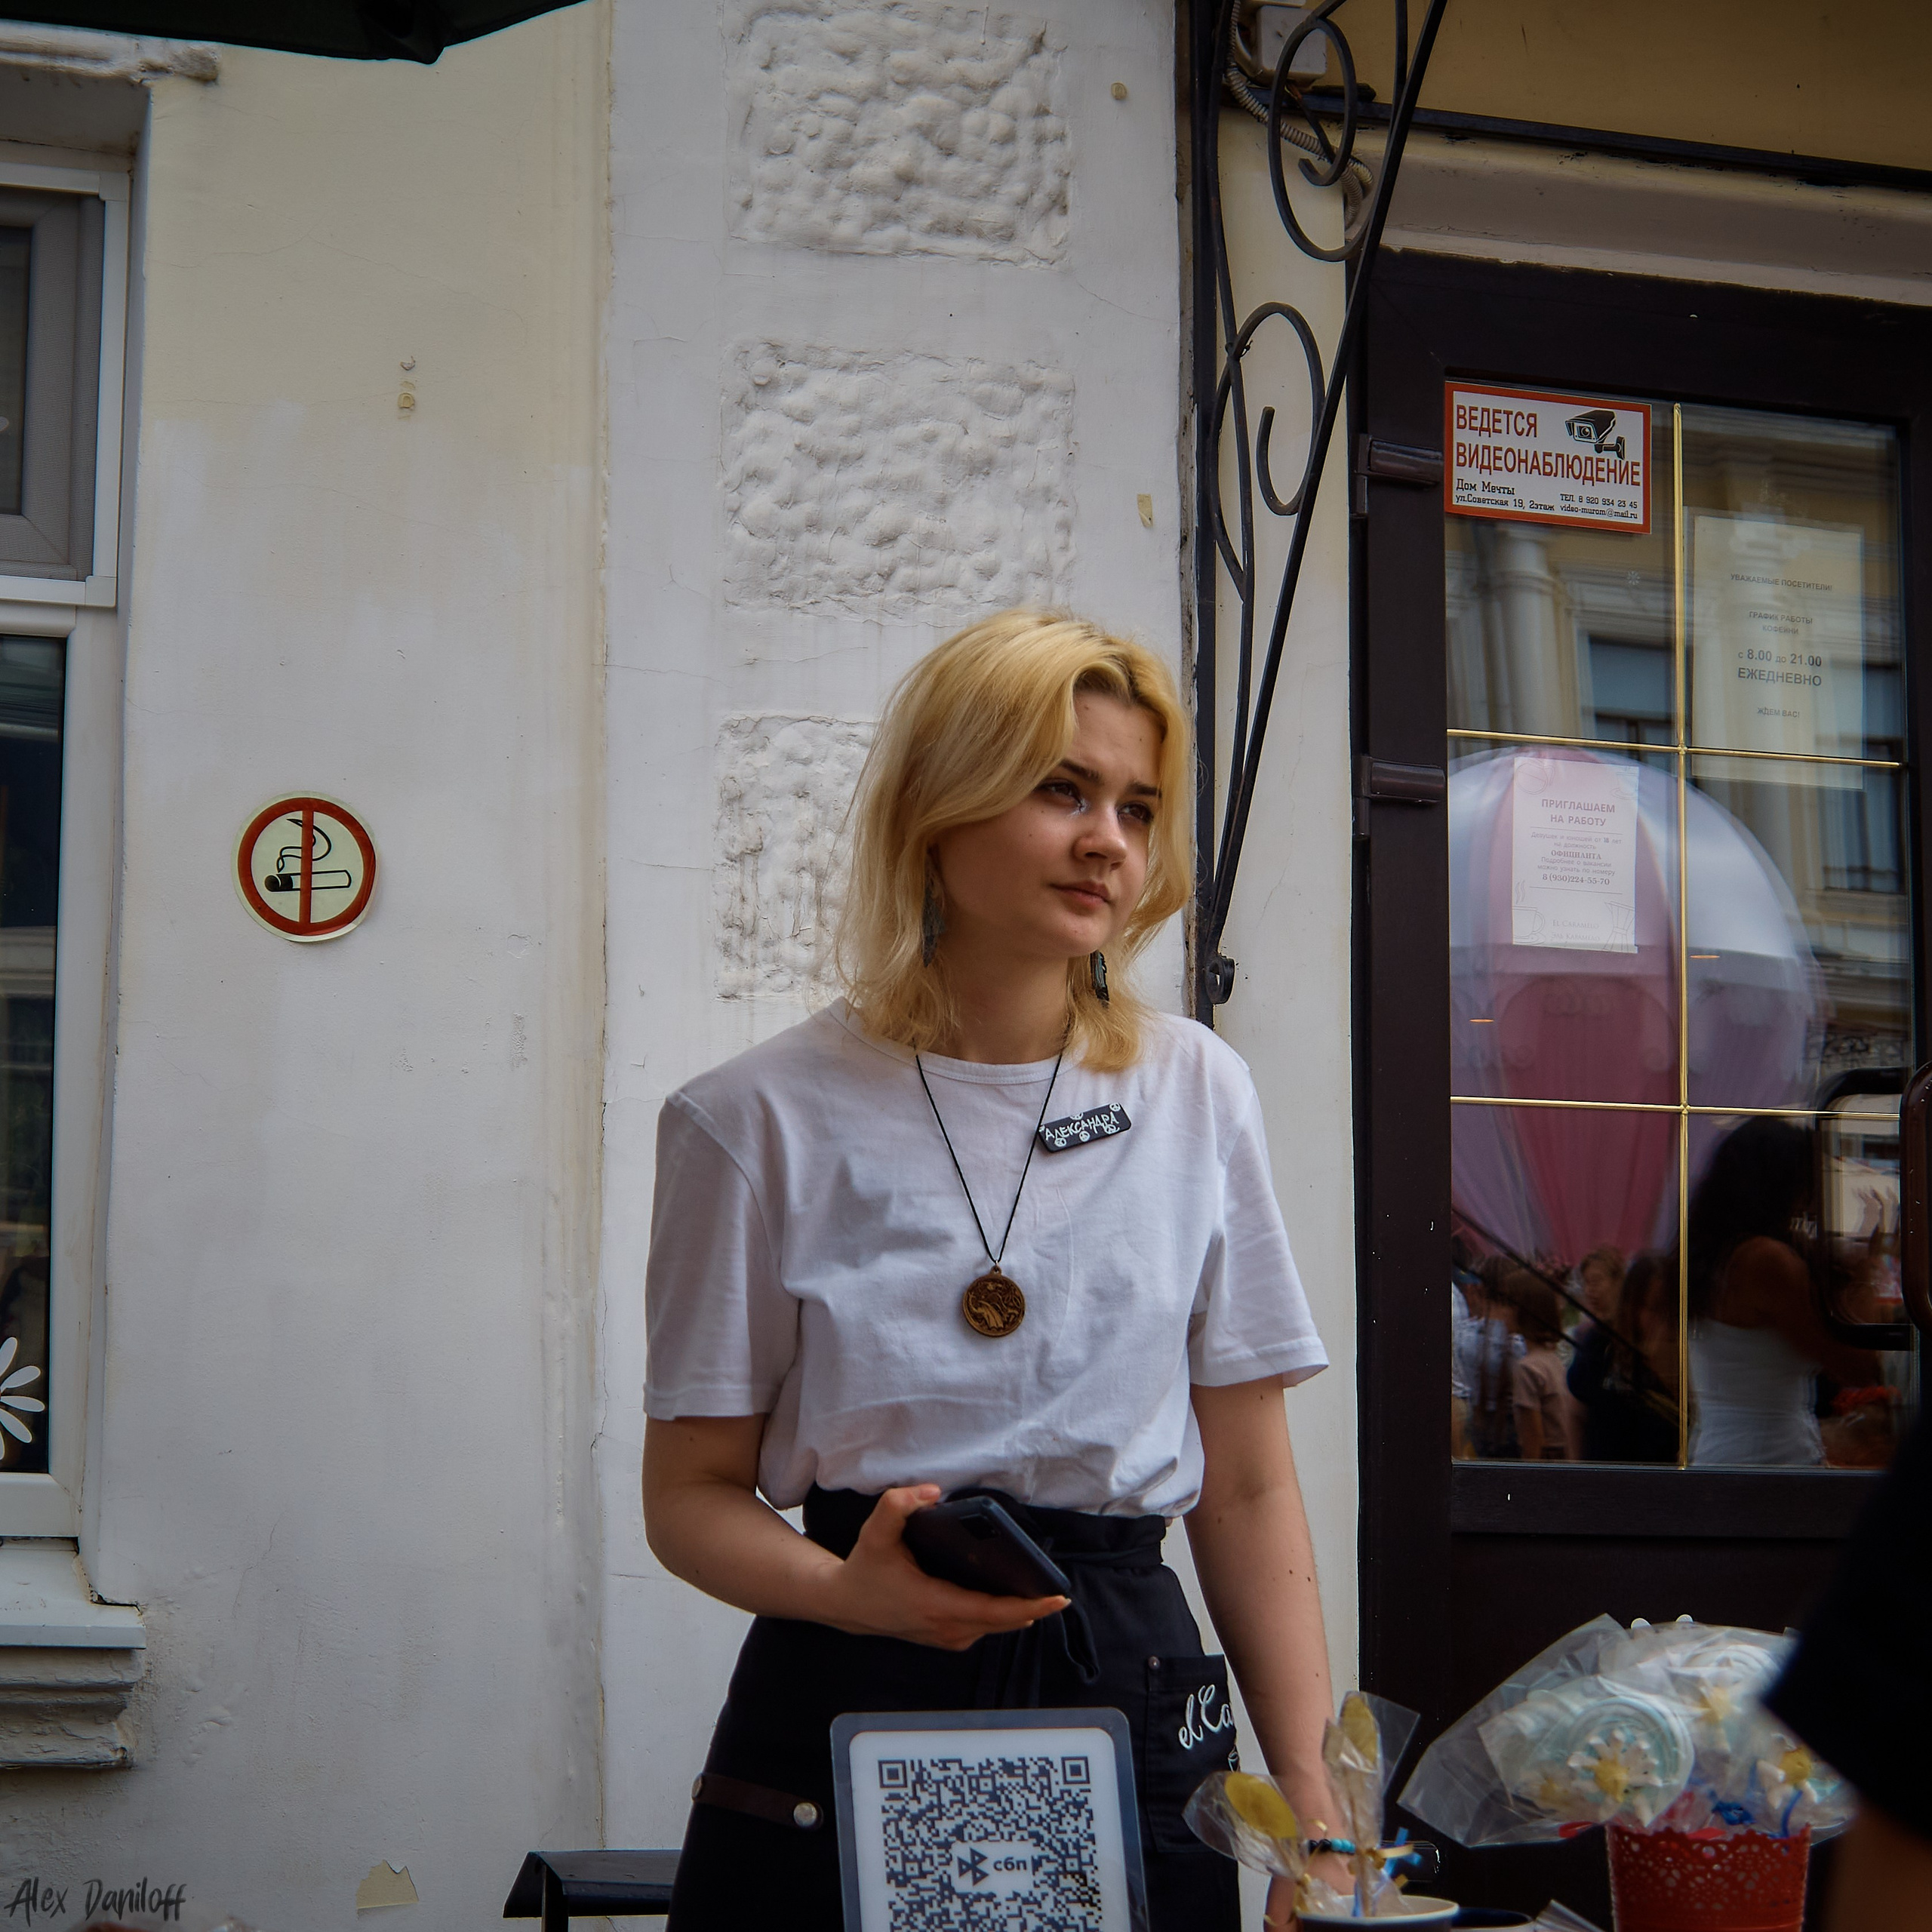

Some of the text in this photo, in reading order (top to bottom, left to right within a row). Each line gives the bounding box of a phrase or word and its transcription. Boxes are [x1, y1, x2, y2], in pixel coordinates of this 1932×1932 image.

[1456, 404, 1538, 438] ВЕДЕТСЯ
[1456, 441, 1641, 487] ВИДЕОНАБЛЮДЕНИЕ
[1457, 478, 1515, 495] Дом Мечты
[1513, 498, 1525, 509] 19,
[1529, 500, 1555, 511] 2этаж
[1586, 496, 1599, 505] 920
[1601, 497, 1614, 506] 934
[1617, 500, 1626, 508] 23
[1560, 503, 1638, 519] video-murom@mail.ru
[1730, 573, 1832, 592] УВАЖАЕМЫЕ ПОСЕТИТЕЛИ!
[1749, 611, 1813, 624] ГРАФИК РАБОТЫ
[1762, 624, 1799, 635] КОФЕЙНИ
[1747, 648, 1772, 662] 8.00
[1775, 655, 1786, 664] до
[1789, 653, 1822, 667] 21.00
[1737, 667, 1822, 687] ЕЖЕДНЕВНО
[1757, 706, 1800, 718] ЖДЕМ ВАС!
[1542, 798, 1616, 814] ПРИГЛАШАЕМ
[1550, 814, 1607, 826] НА РАБОТУ
[1551, 850, 1602, 860] ОФИЦИАНТА
[1549, 873, 1610, 885] (930)224-55-70
[1045, 1111, 1120, 1140] АЛЕКСАНДРА
[992, 1857, 1028, 1873] сбп
